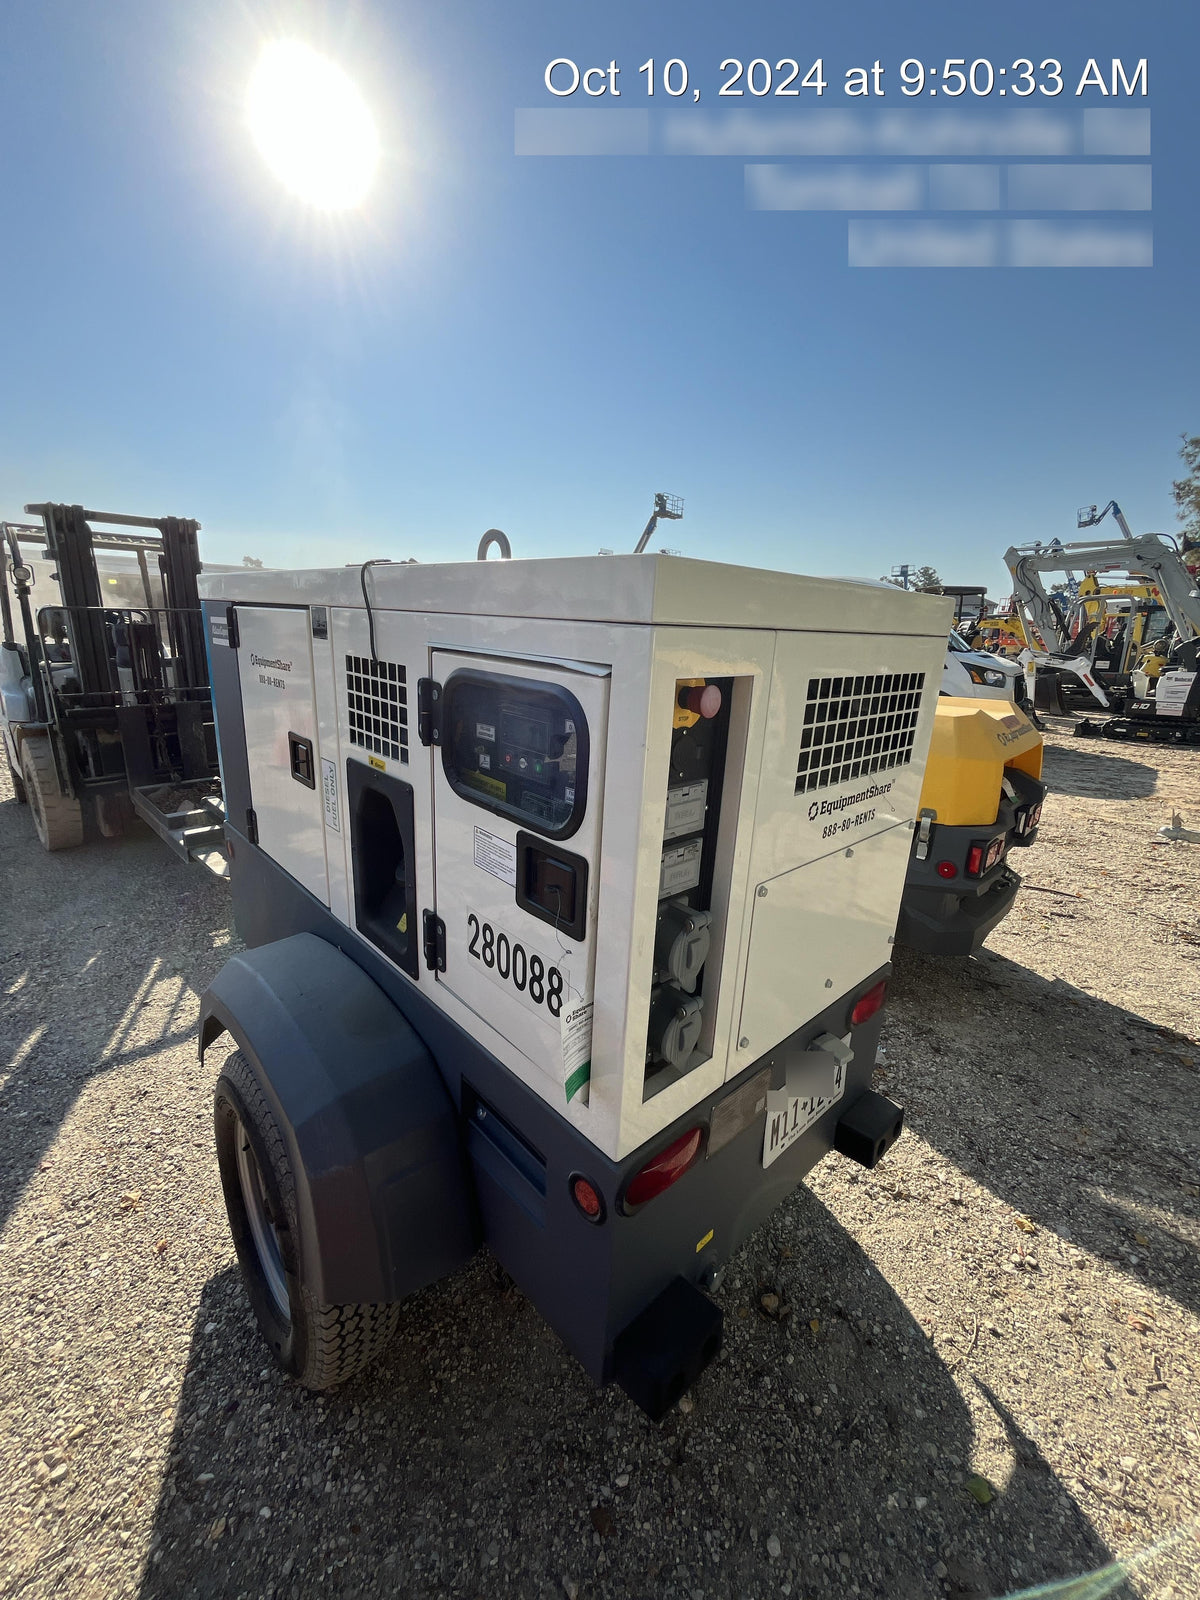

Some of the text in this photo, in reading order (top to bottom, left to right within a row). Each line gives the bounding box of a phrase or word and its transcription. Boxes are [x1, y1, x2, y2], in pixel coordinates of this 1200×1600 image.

[328, 766, 338, 827] FUEL ONLY
[820, 782, 892, 815] EquipmentShare
[822, 808, 876, 839] 888-80-RENTS
[467, 913, 563, 1018] 280088
